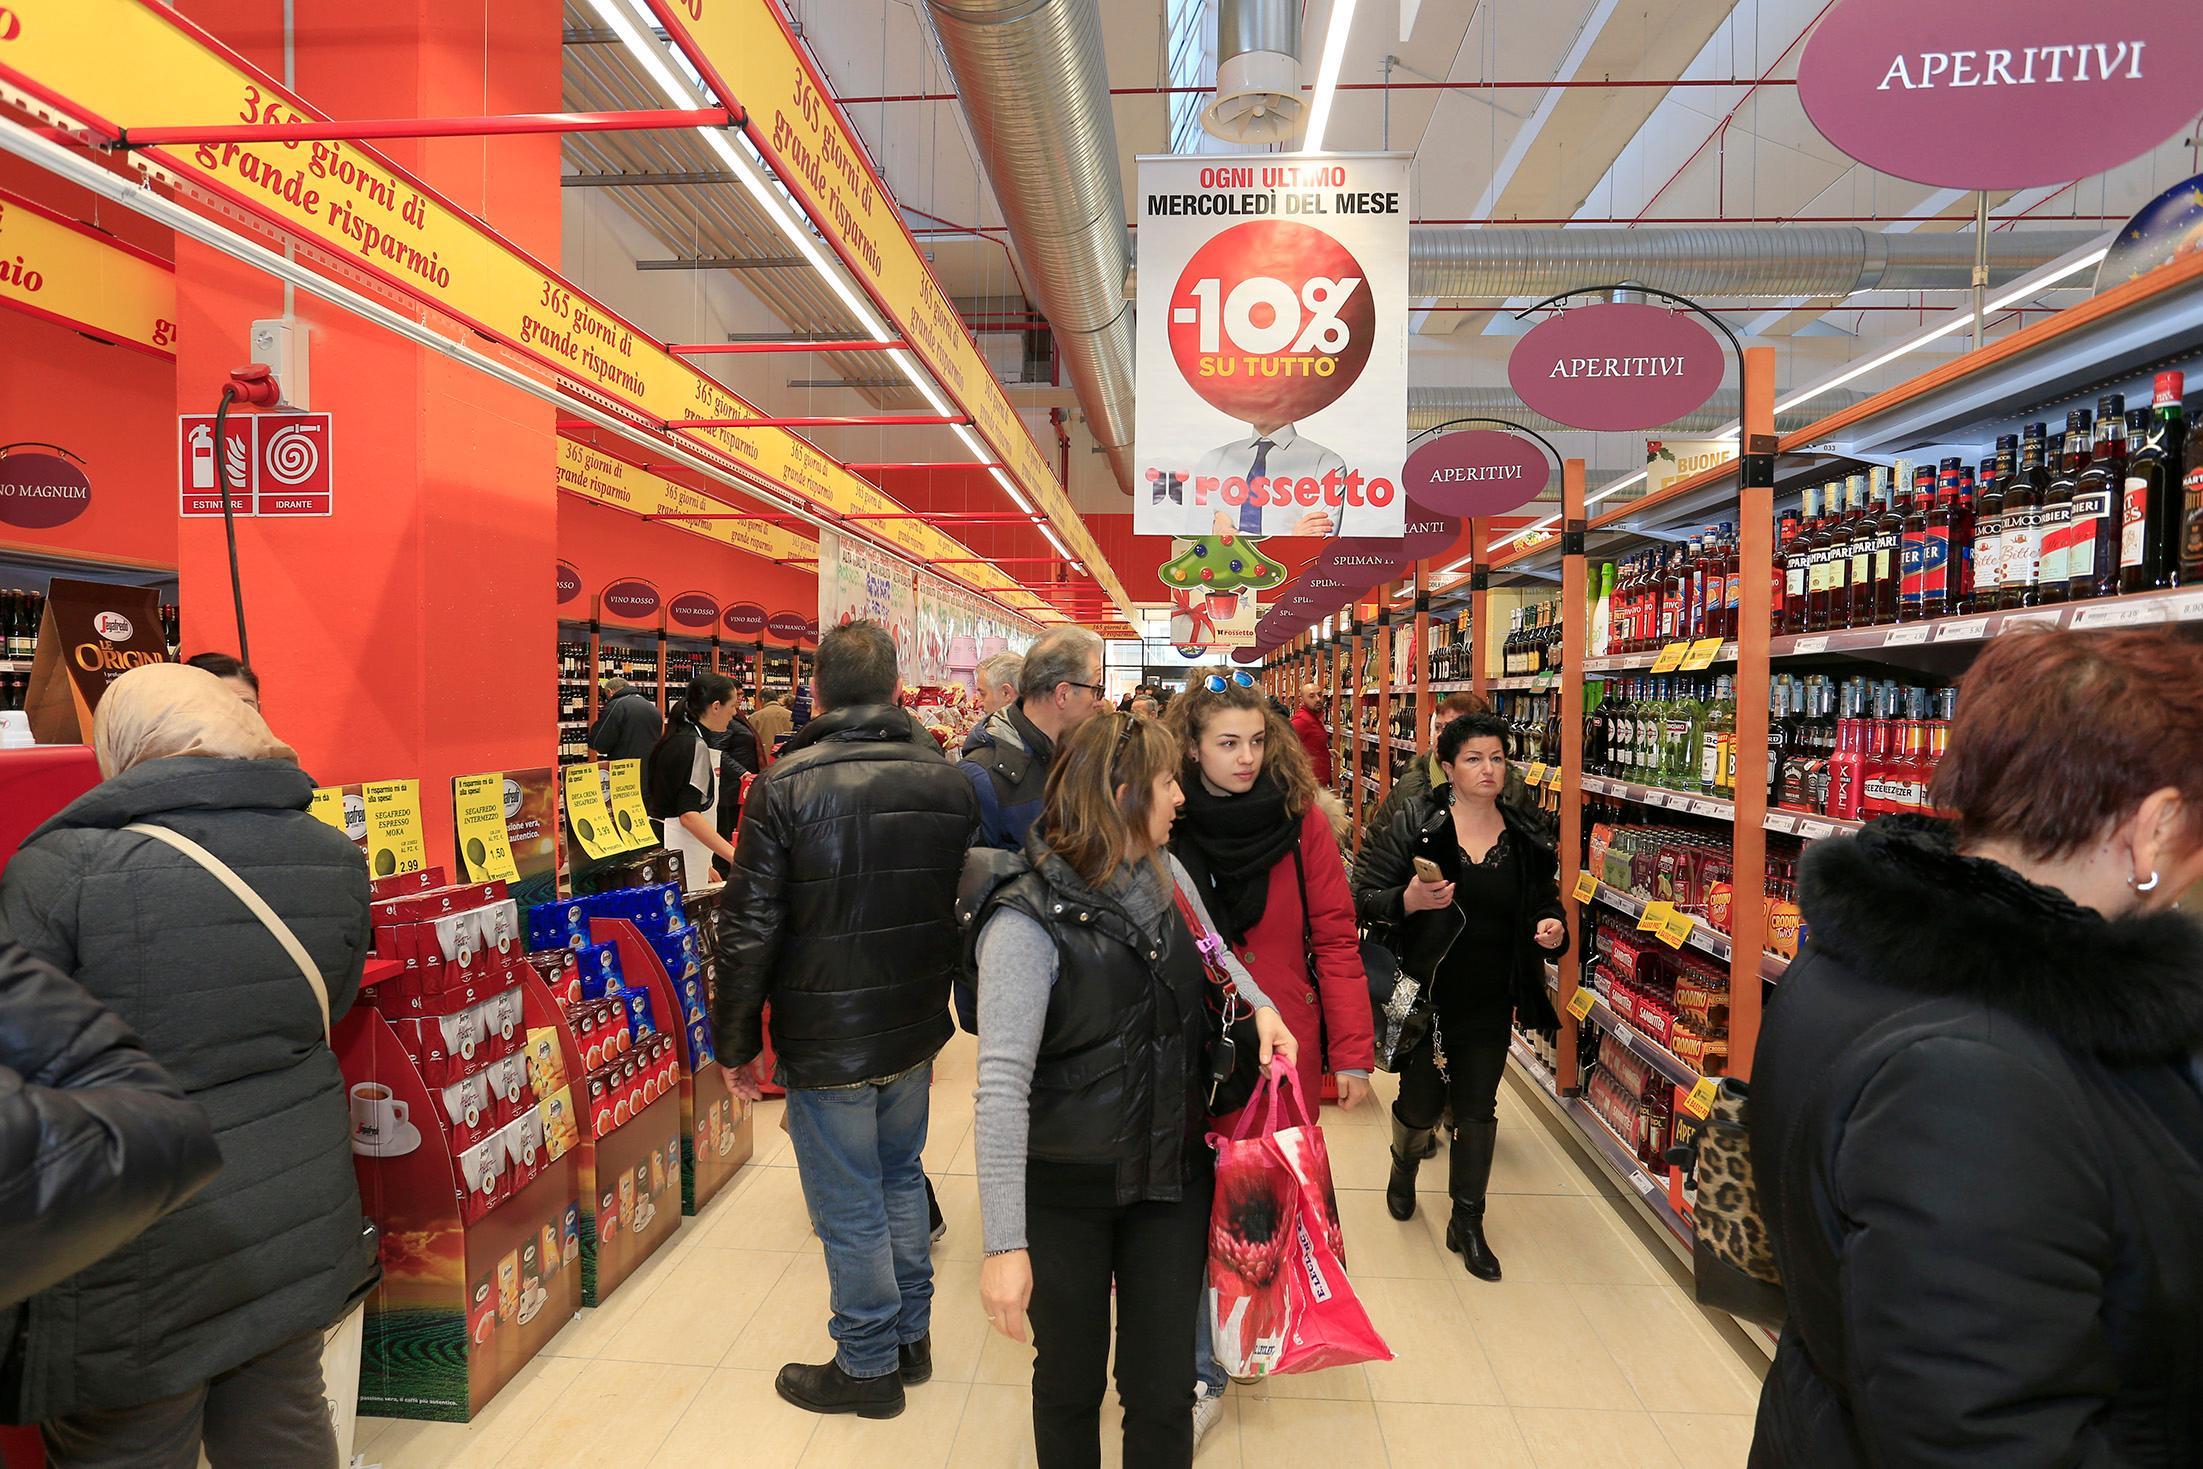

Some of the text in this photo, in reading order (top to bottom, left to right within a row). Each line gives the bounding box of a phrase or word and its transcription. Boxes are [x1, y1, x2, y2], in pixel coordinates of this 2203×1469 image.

[1876, 41, 2147, 90] APERITIVI
[792, 66, 873, 217] 365 giorni di
[309, 140, 400, 210] giorni
[402, 192, 426, 231] di
[1200, 166, 1346, 188] OGNI ULTMO
[772, 109, 882, 277] grande risparmio
[1148, 189, 1399, 215] MERCOLEDÌ DEL MESE
[195, 142, 450, 289] grande risparmio
[540, 281, 632, 358] 365 giorni di
[1173, 277, 1362, 355] -10%
[520, 314, 646, 398] grande risparmio
[1199, 356, 1235, 377] SU
[1549, 356, 1685, 379] APERITIVI
[695, 379, 713, 406] 365
[717, 423, 759, 461] risparmio
[791, 440, 803, 462] 365
[566, 442, 622, 478] 365 giorni di
[1429, 464, 1523, 483] APERITIVI
[19, 484, 87, 499] MAGNUM
[590, 478, 631, 503] risparmio
[664, 482, 678, 501] 365
[679, 488, 699, 508] giorni
[1195, 468, 1395, 508] rossetto
[193, 500, 313, 509] ESTINTRE IDRANTE
[1404, 521, 1445, 534] ANTI
[1333, 555, 1395, 566] SPUMAN
[610, 596, 654, 605] VINO ROSSO
[730, 615, 746, 623] VINO
[99, 640, 114, 651] LE
[375, 809, 411, 819] SEGAFREDO
[464, 813, 499, 824] INTERMEZZO
[465, 804, 497, 815] SEGAFREDO
[378, 818, 410, 828] ESPRESSO
[386, 829, 404, 837] MOKA
[400, 859, 418, 873] 2.99
[1677, 989, 1707, 1008] CRODINO
[1672, 1036, 1701, 1056] CRODINO
